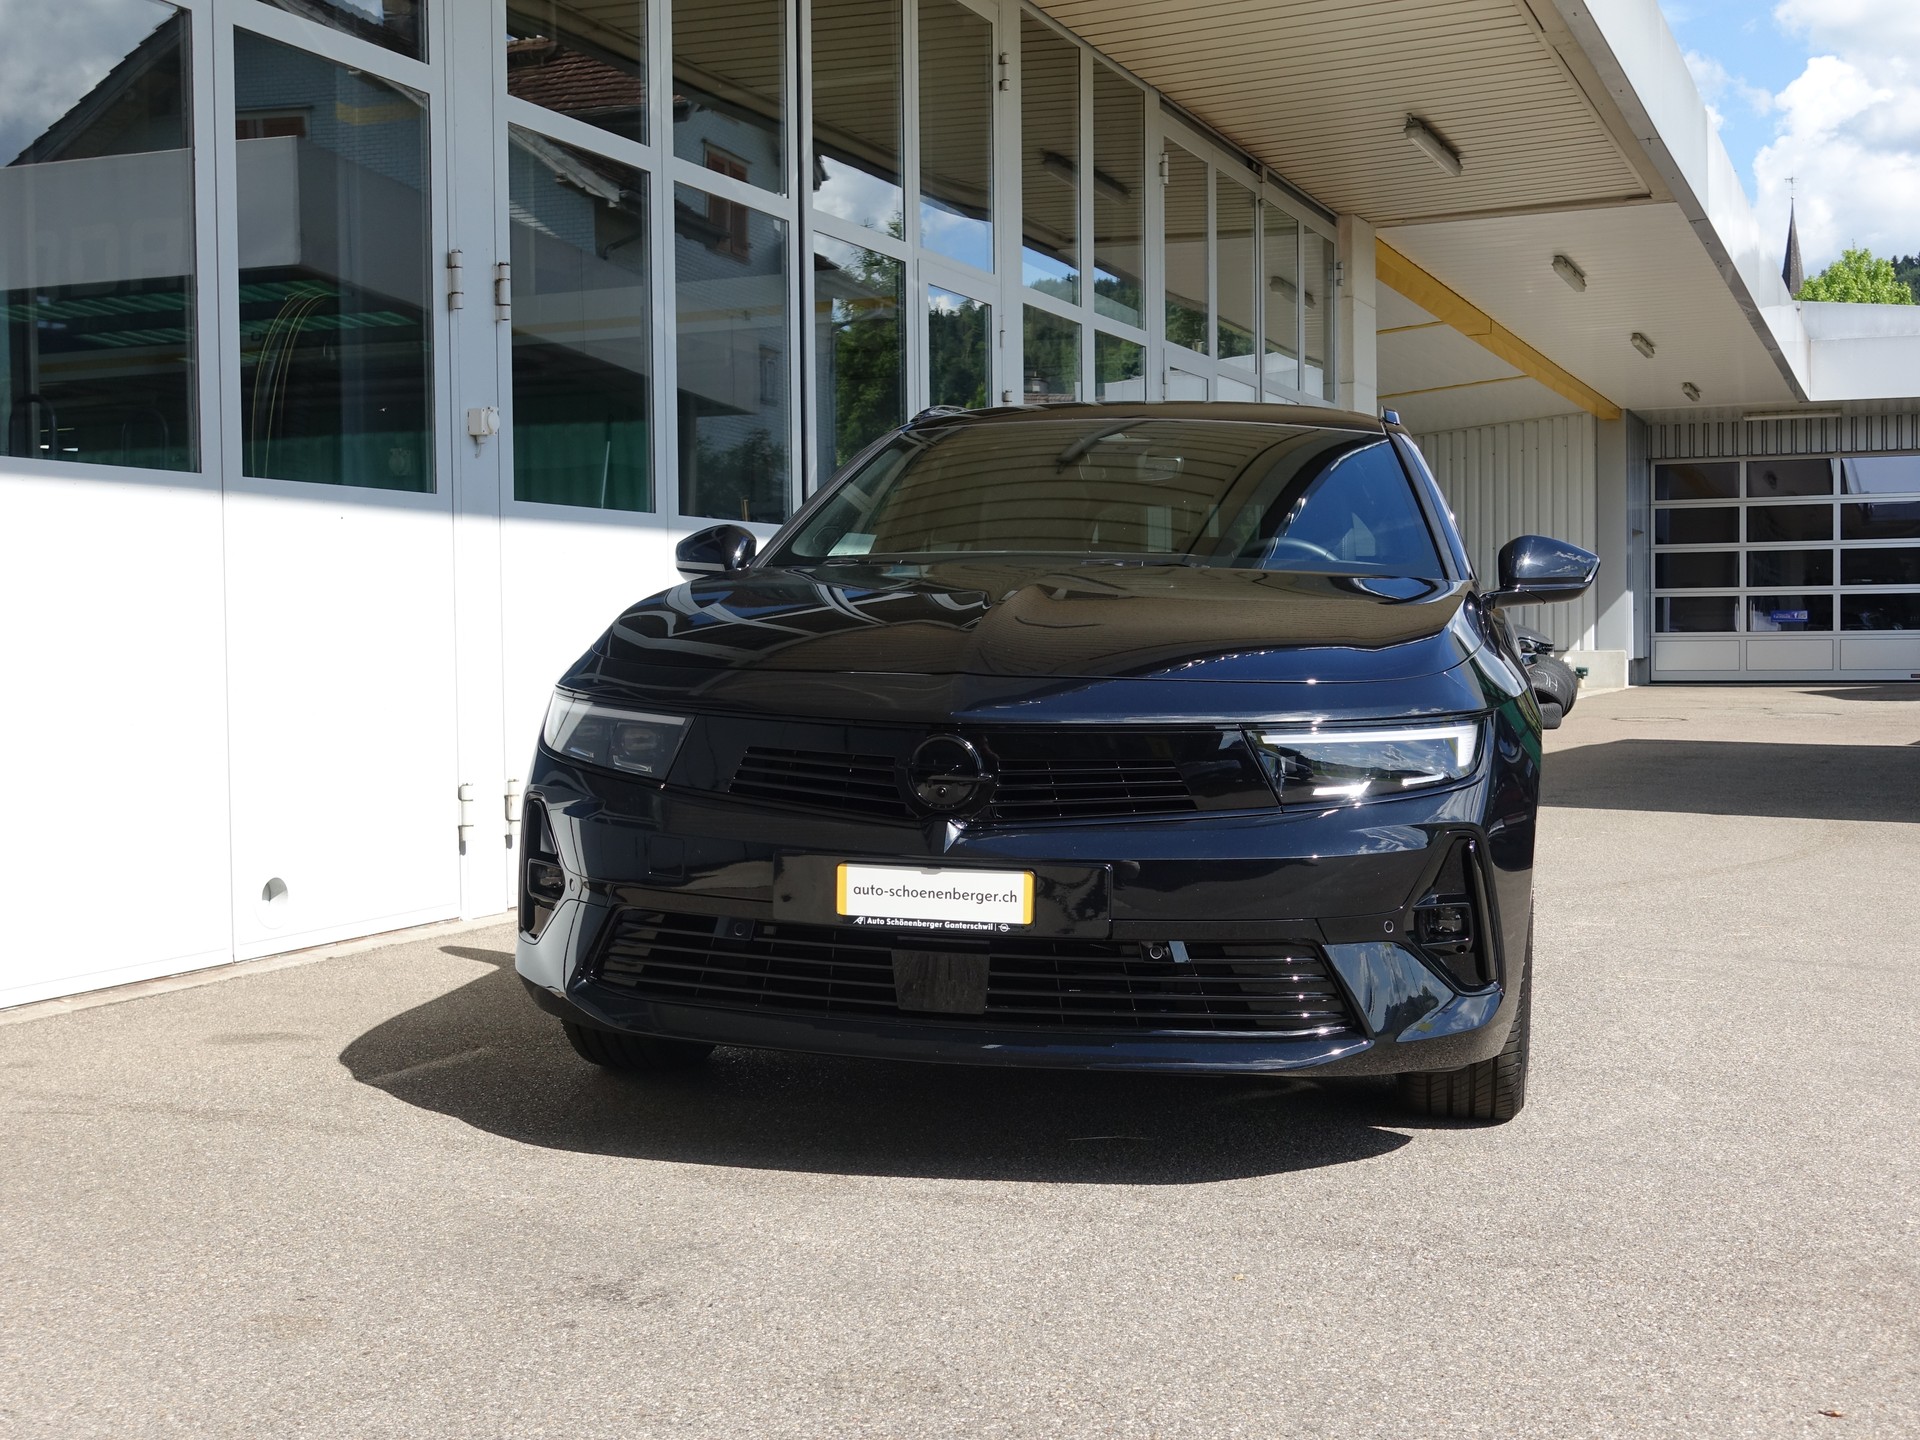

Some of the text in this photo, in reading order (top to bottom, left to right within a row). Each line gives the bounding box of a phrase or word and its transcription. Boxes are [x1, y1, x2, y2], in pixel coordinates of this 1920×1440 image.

[853, 884, 1018, 905] auto-schoenenberger.ch
[866, 917, 994, 931] Auto Schönenberger Ganterschwil
